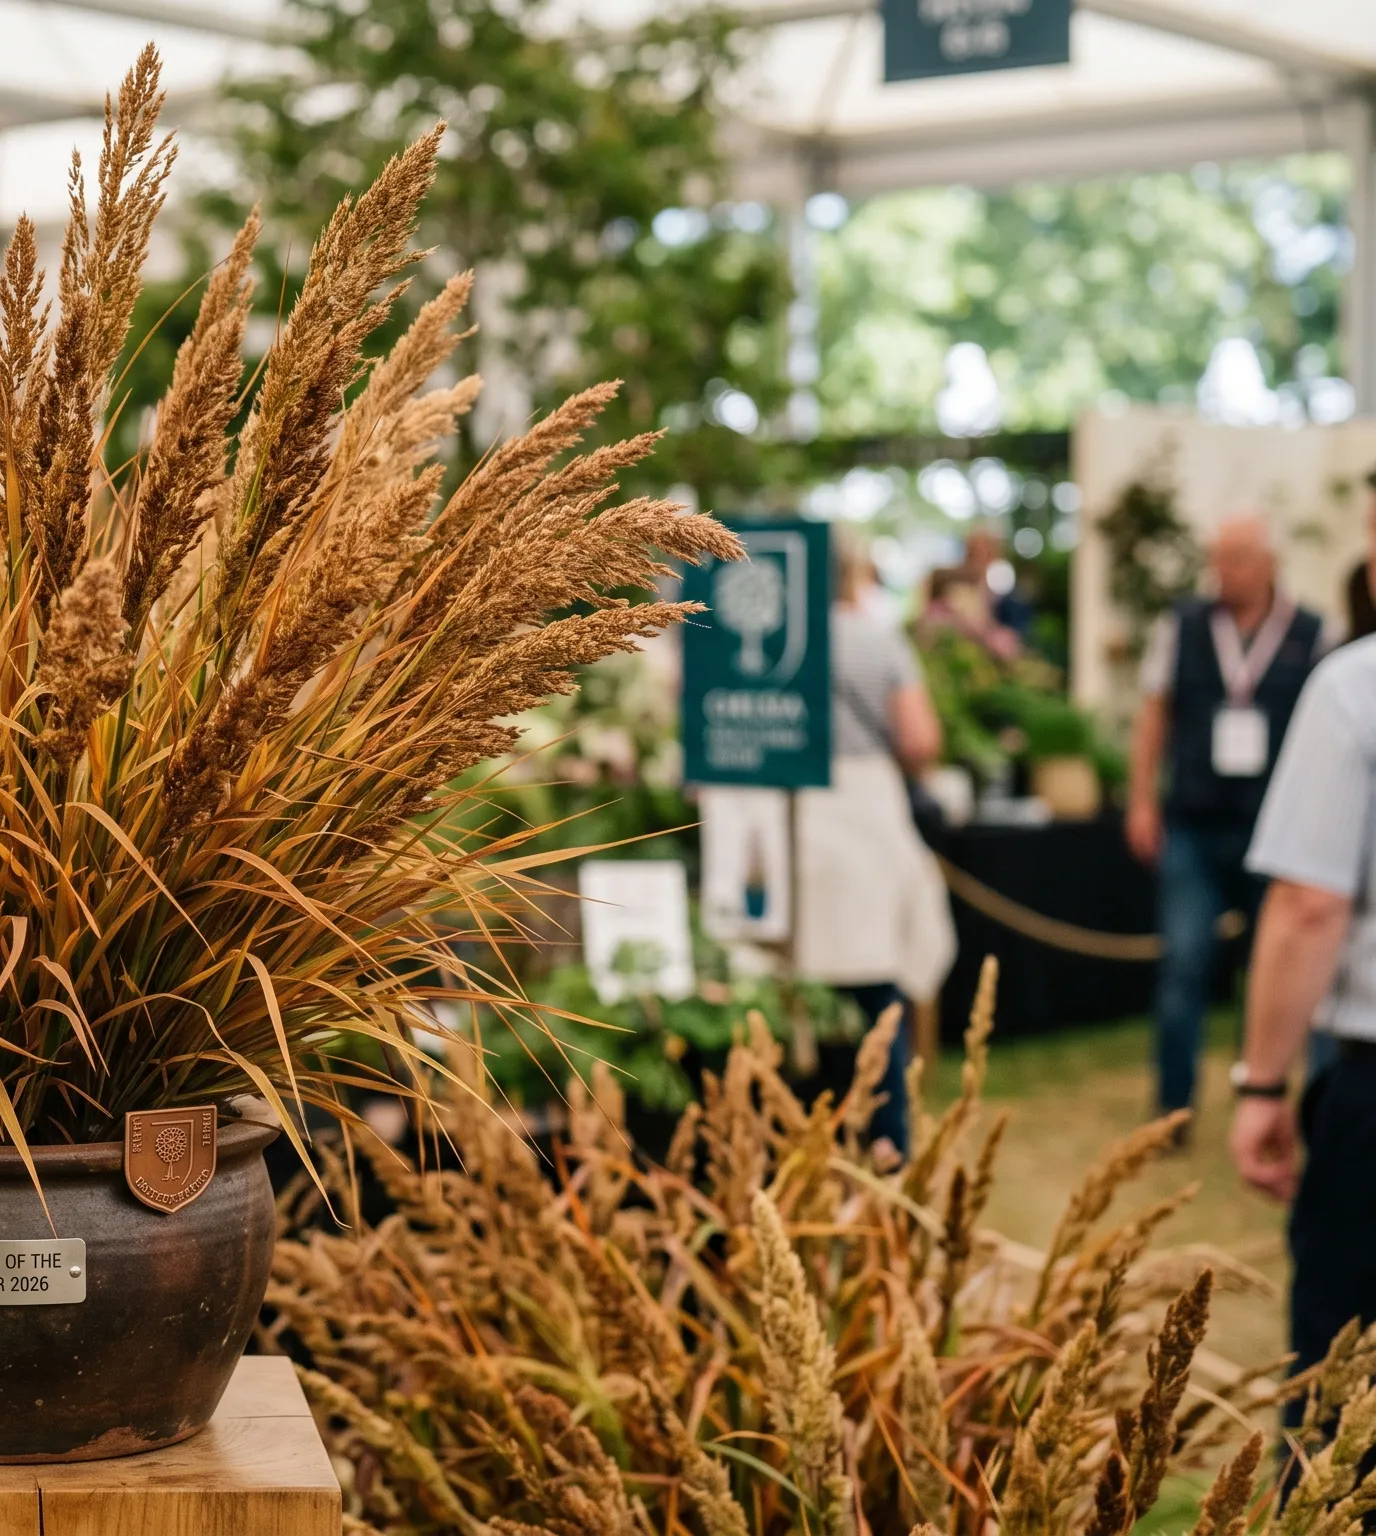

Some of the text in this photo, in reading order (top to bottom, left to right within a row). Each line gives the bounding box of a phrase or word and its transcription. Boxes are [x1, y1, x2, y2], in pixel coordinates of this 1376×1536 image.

[5, 1253, 26, 1269] OF
[31, 1253, 62, 1269] THE
[10, 1276, 49, 1292] 2026
